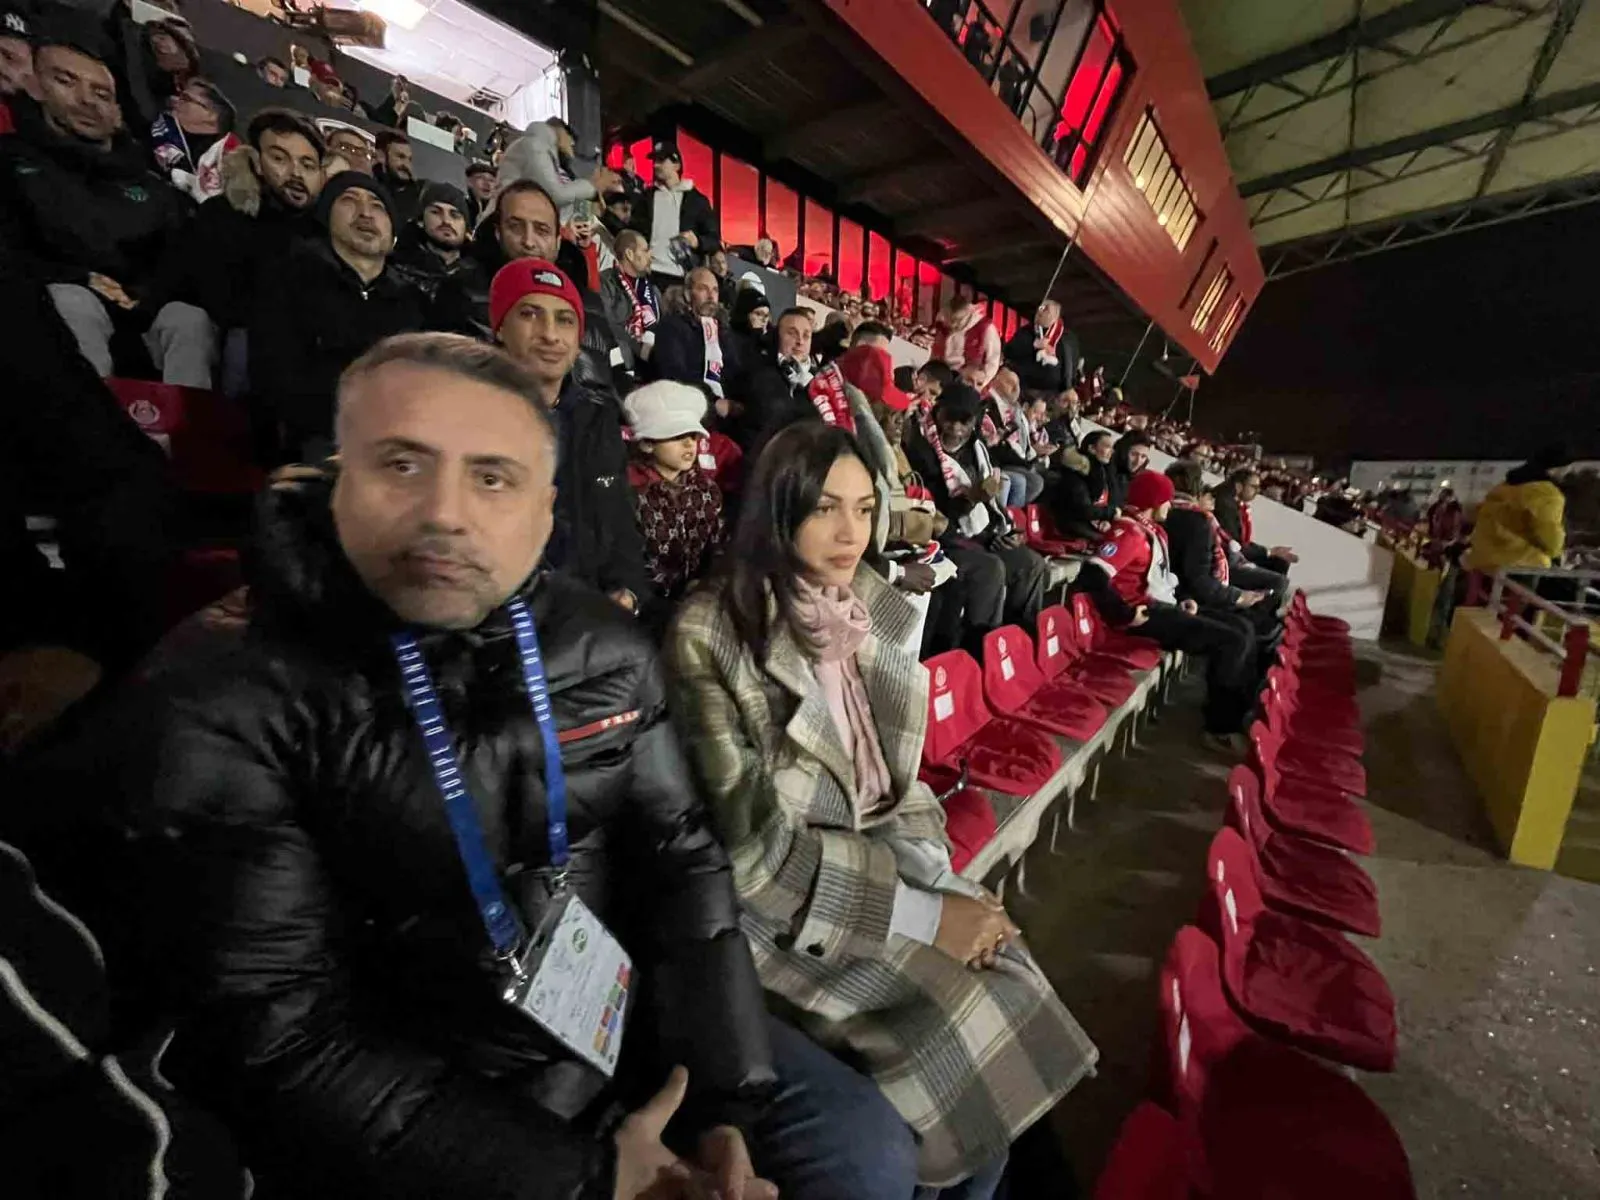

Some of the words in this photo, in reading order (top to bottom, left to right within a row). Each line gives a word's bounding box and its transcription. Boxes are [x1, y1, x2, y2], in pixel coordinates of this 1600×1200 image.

[396, 641, 436, 706] FRANCE
[521, 647, 540, 665] DE
[525, 675, 551, 722] COUPE
[418, 715, 445, 737] DE
[430, 746, 466, 800] COUPE
